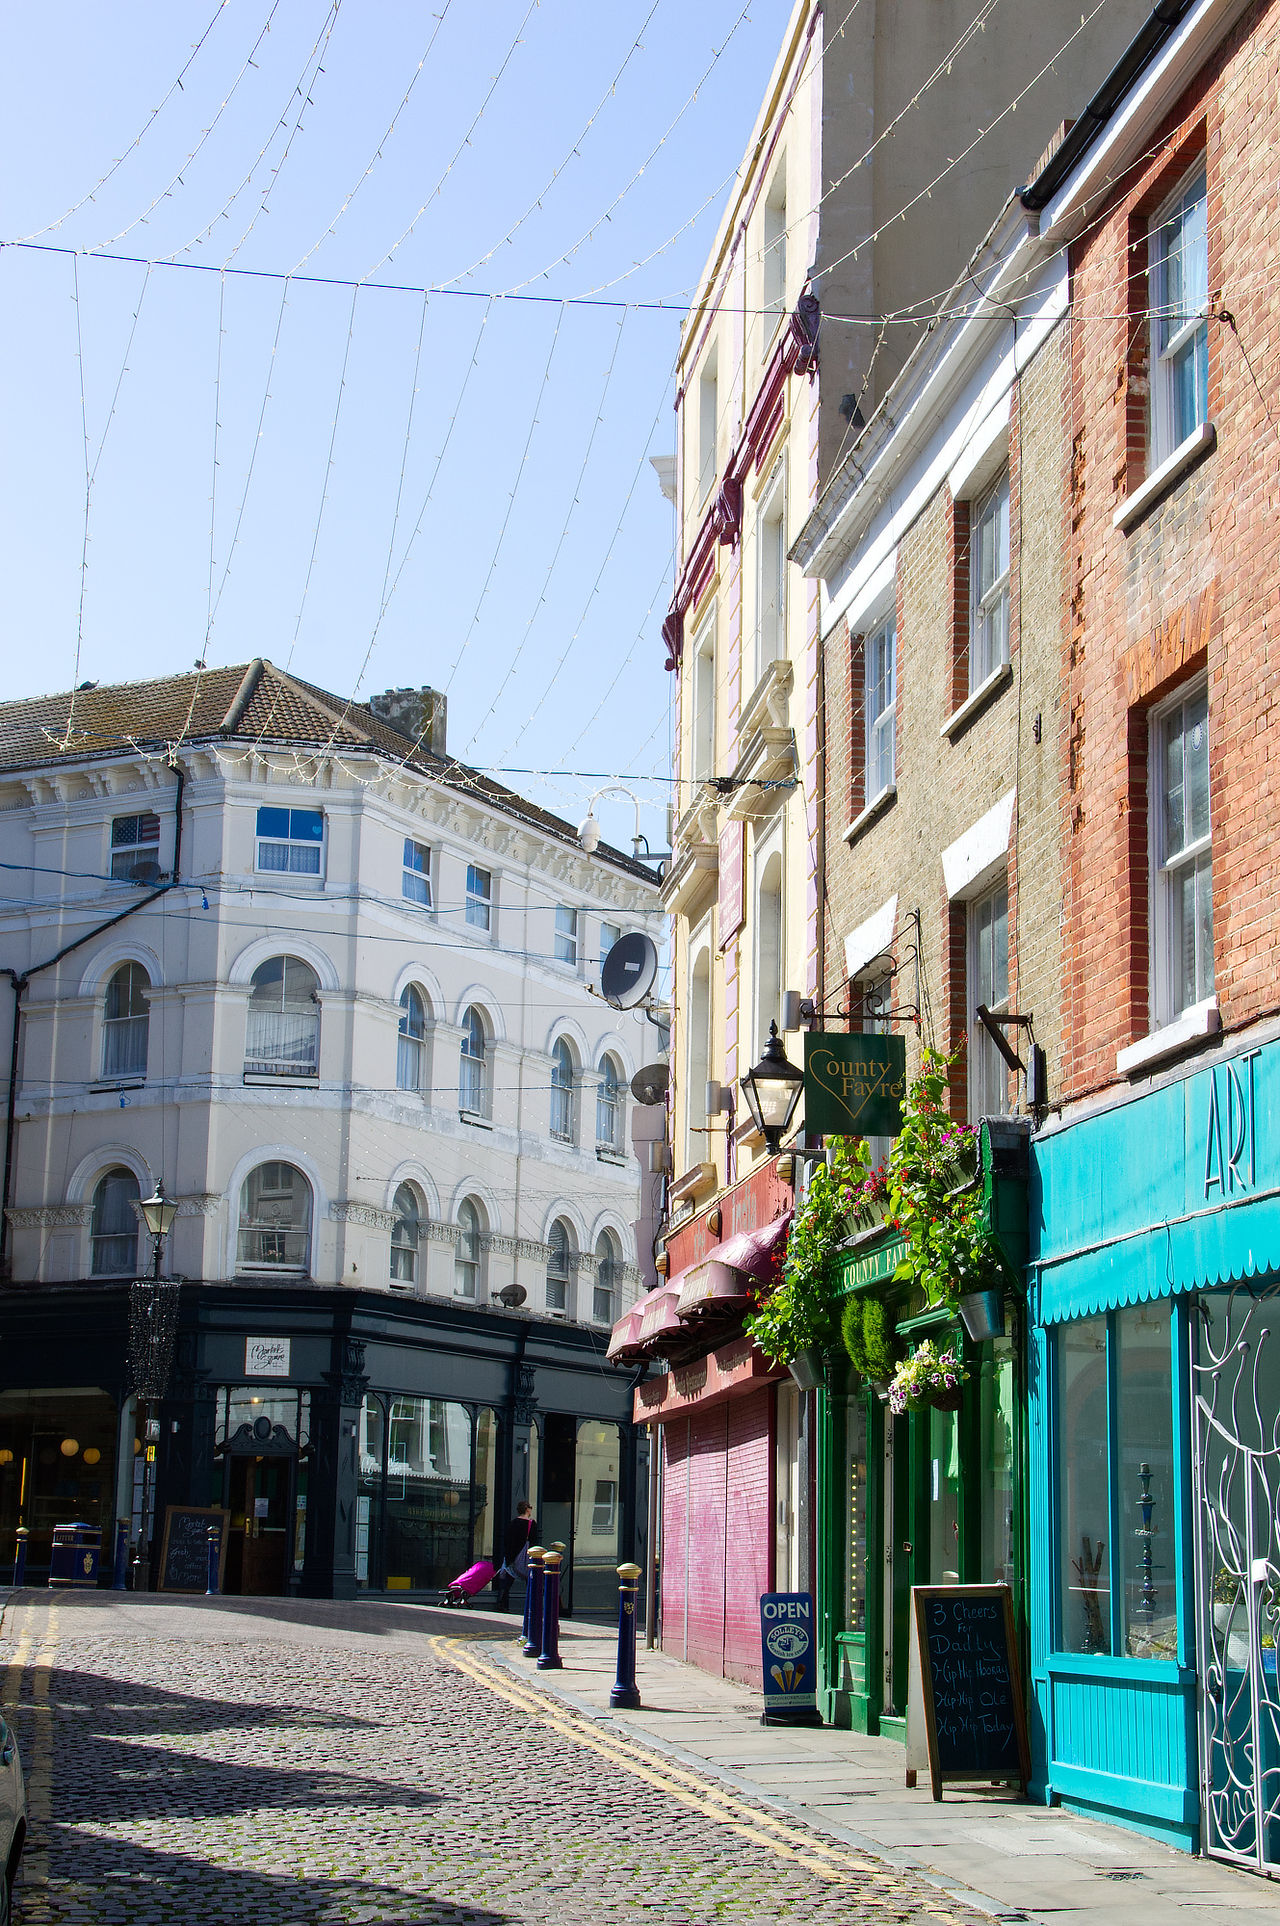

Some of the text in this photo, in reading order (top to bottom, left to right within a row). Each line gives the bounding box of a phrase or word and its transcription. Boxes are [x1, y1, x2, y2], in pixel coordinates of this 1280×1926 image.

[841, 1077, 902, 1098] Fayre
[1204, 1049, 1262, 1200] ART
[843, 1240, 915, 1289] COUNTY FAYR
[763, 1602, 810, 1619] OPEN
[933, 1601, 997, 1626] 3 Cheers
